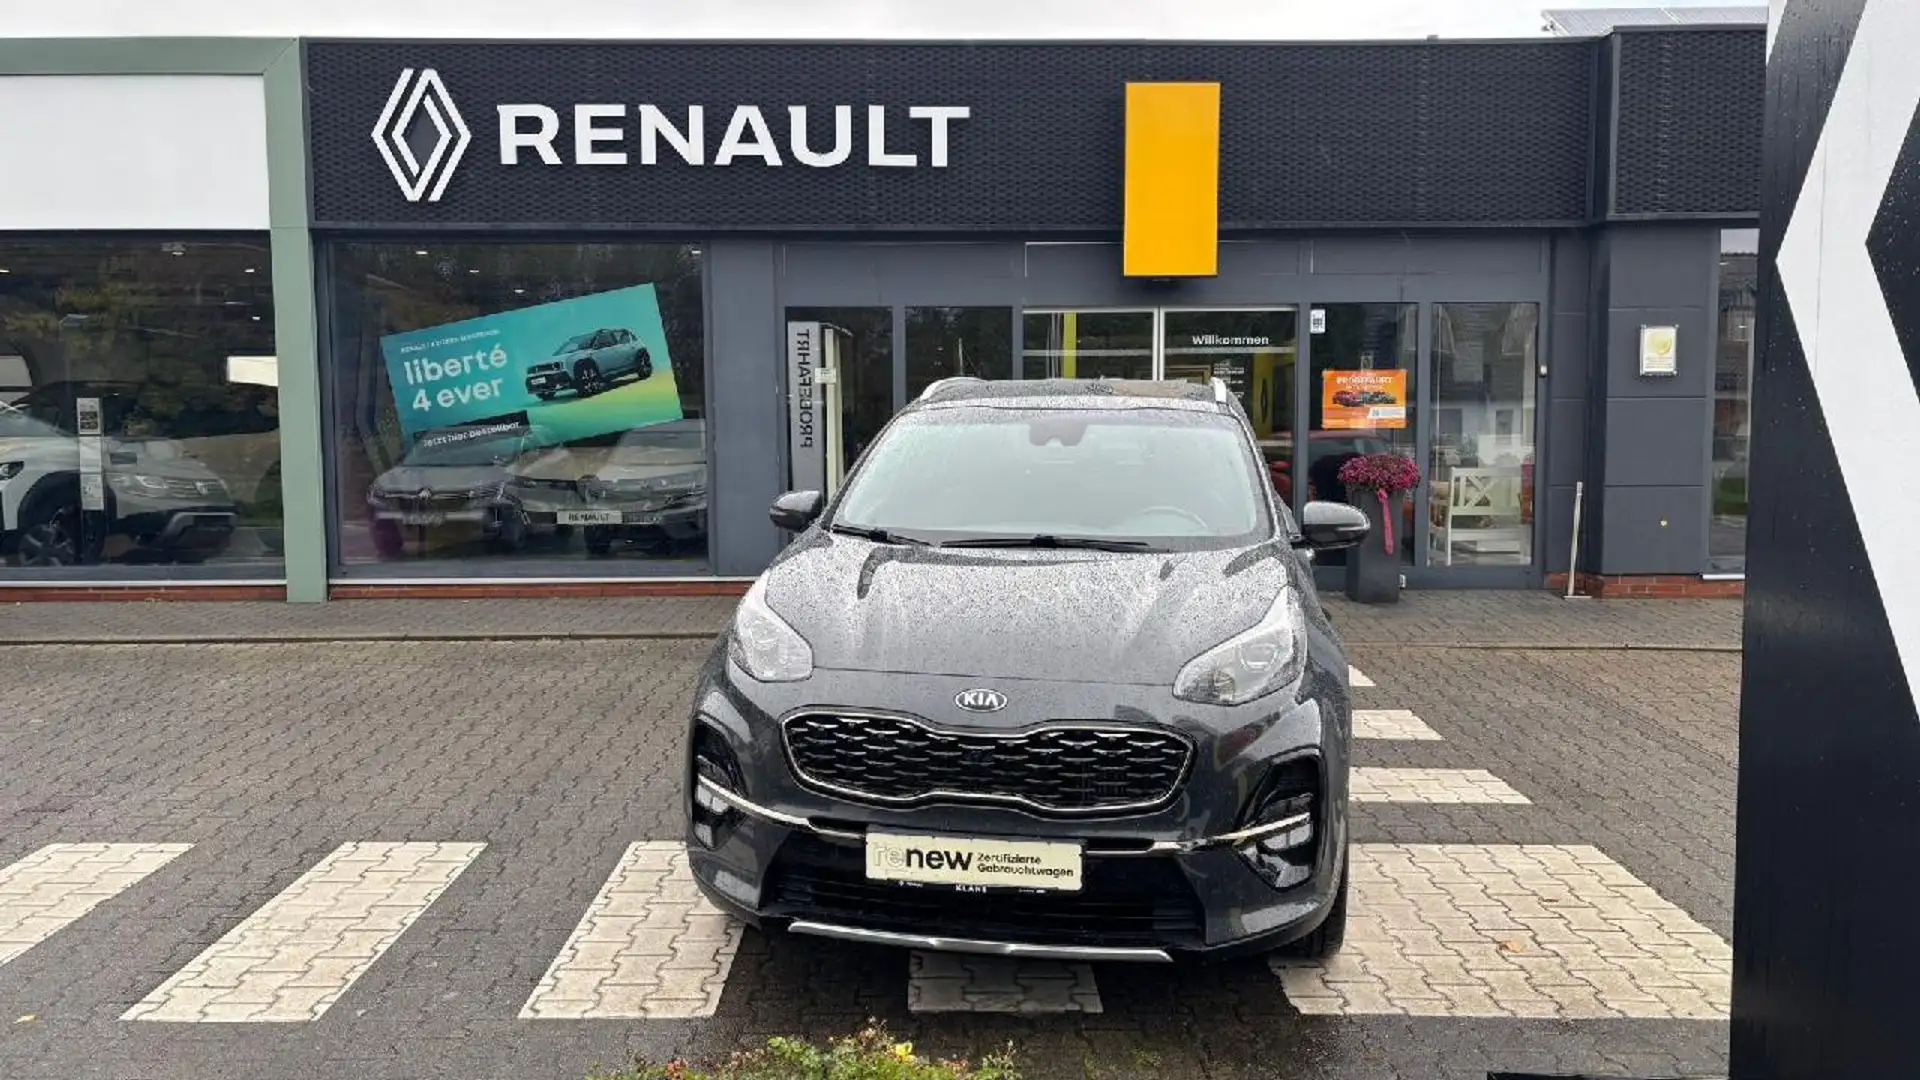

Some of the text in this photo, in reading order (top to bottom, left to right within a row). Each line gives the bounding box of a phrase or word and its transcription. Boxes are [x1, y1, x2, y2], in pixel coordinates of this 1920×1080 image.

[497, 103, 970, 168] RENAULT
[1192, 334, 1270, 345] Willkommen
[404, 343, 508, 385] liberté
[412, 378, 503, 412] 4 ever
[963, 692, 999, 706] KIA
[872, 841, 973, 872] renew
[977, 852, 1041, 865] Zertifizierte
[977, 863, 1074, 879] Gebrauchtwagen
